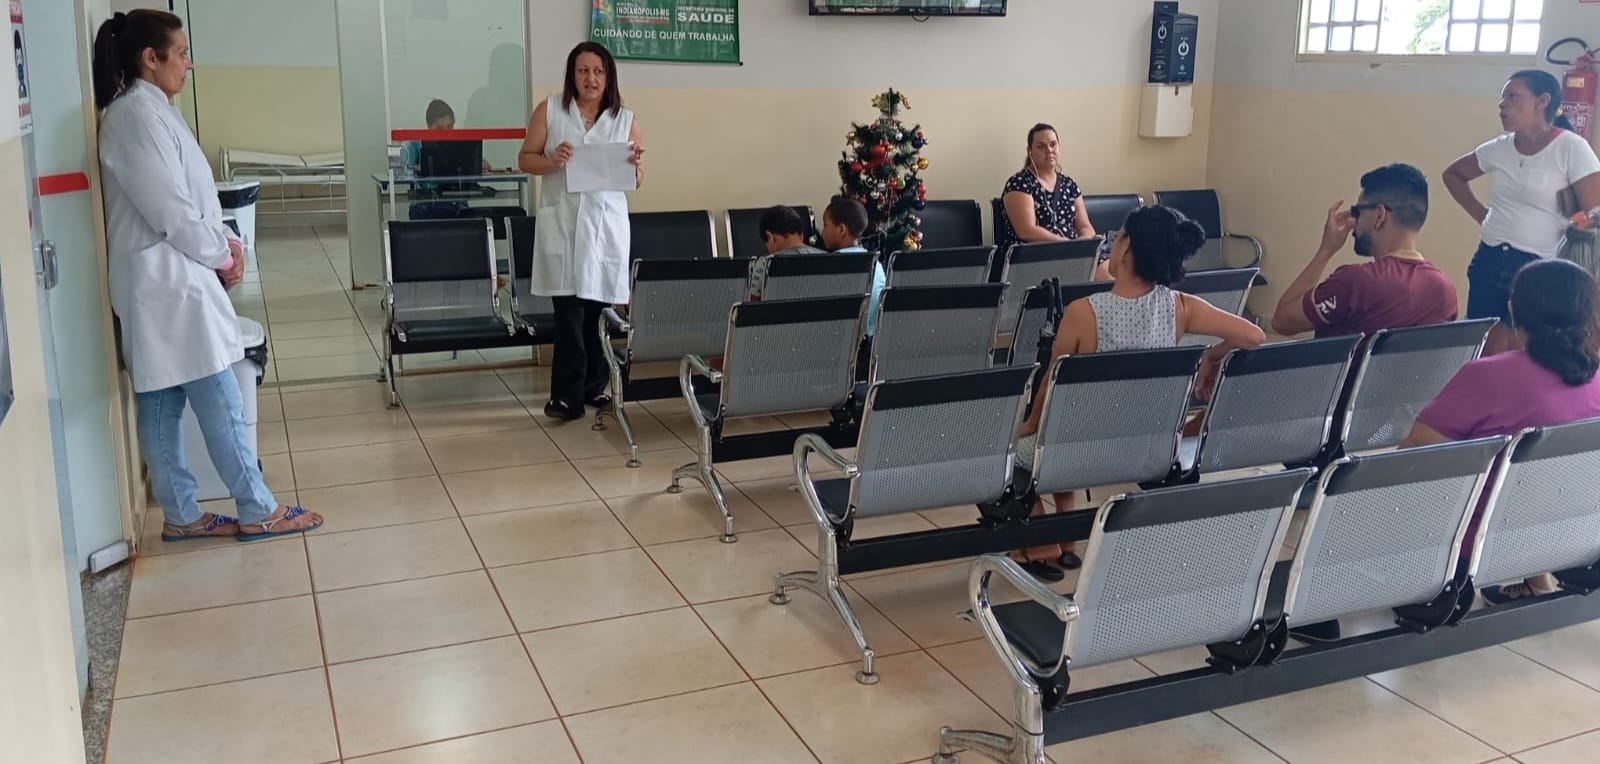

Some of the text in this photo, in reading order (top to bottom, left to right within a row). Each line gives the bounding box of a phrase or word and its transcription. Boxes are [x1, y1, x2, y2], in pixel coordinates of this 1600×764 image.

[594, 28, 735, 41] CUIDANDO DE QUEM TRABALHA
